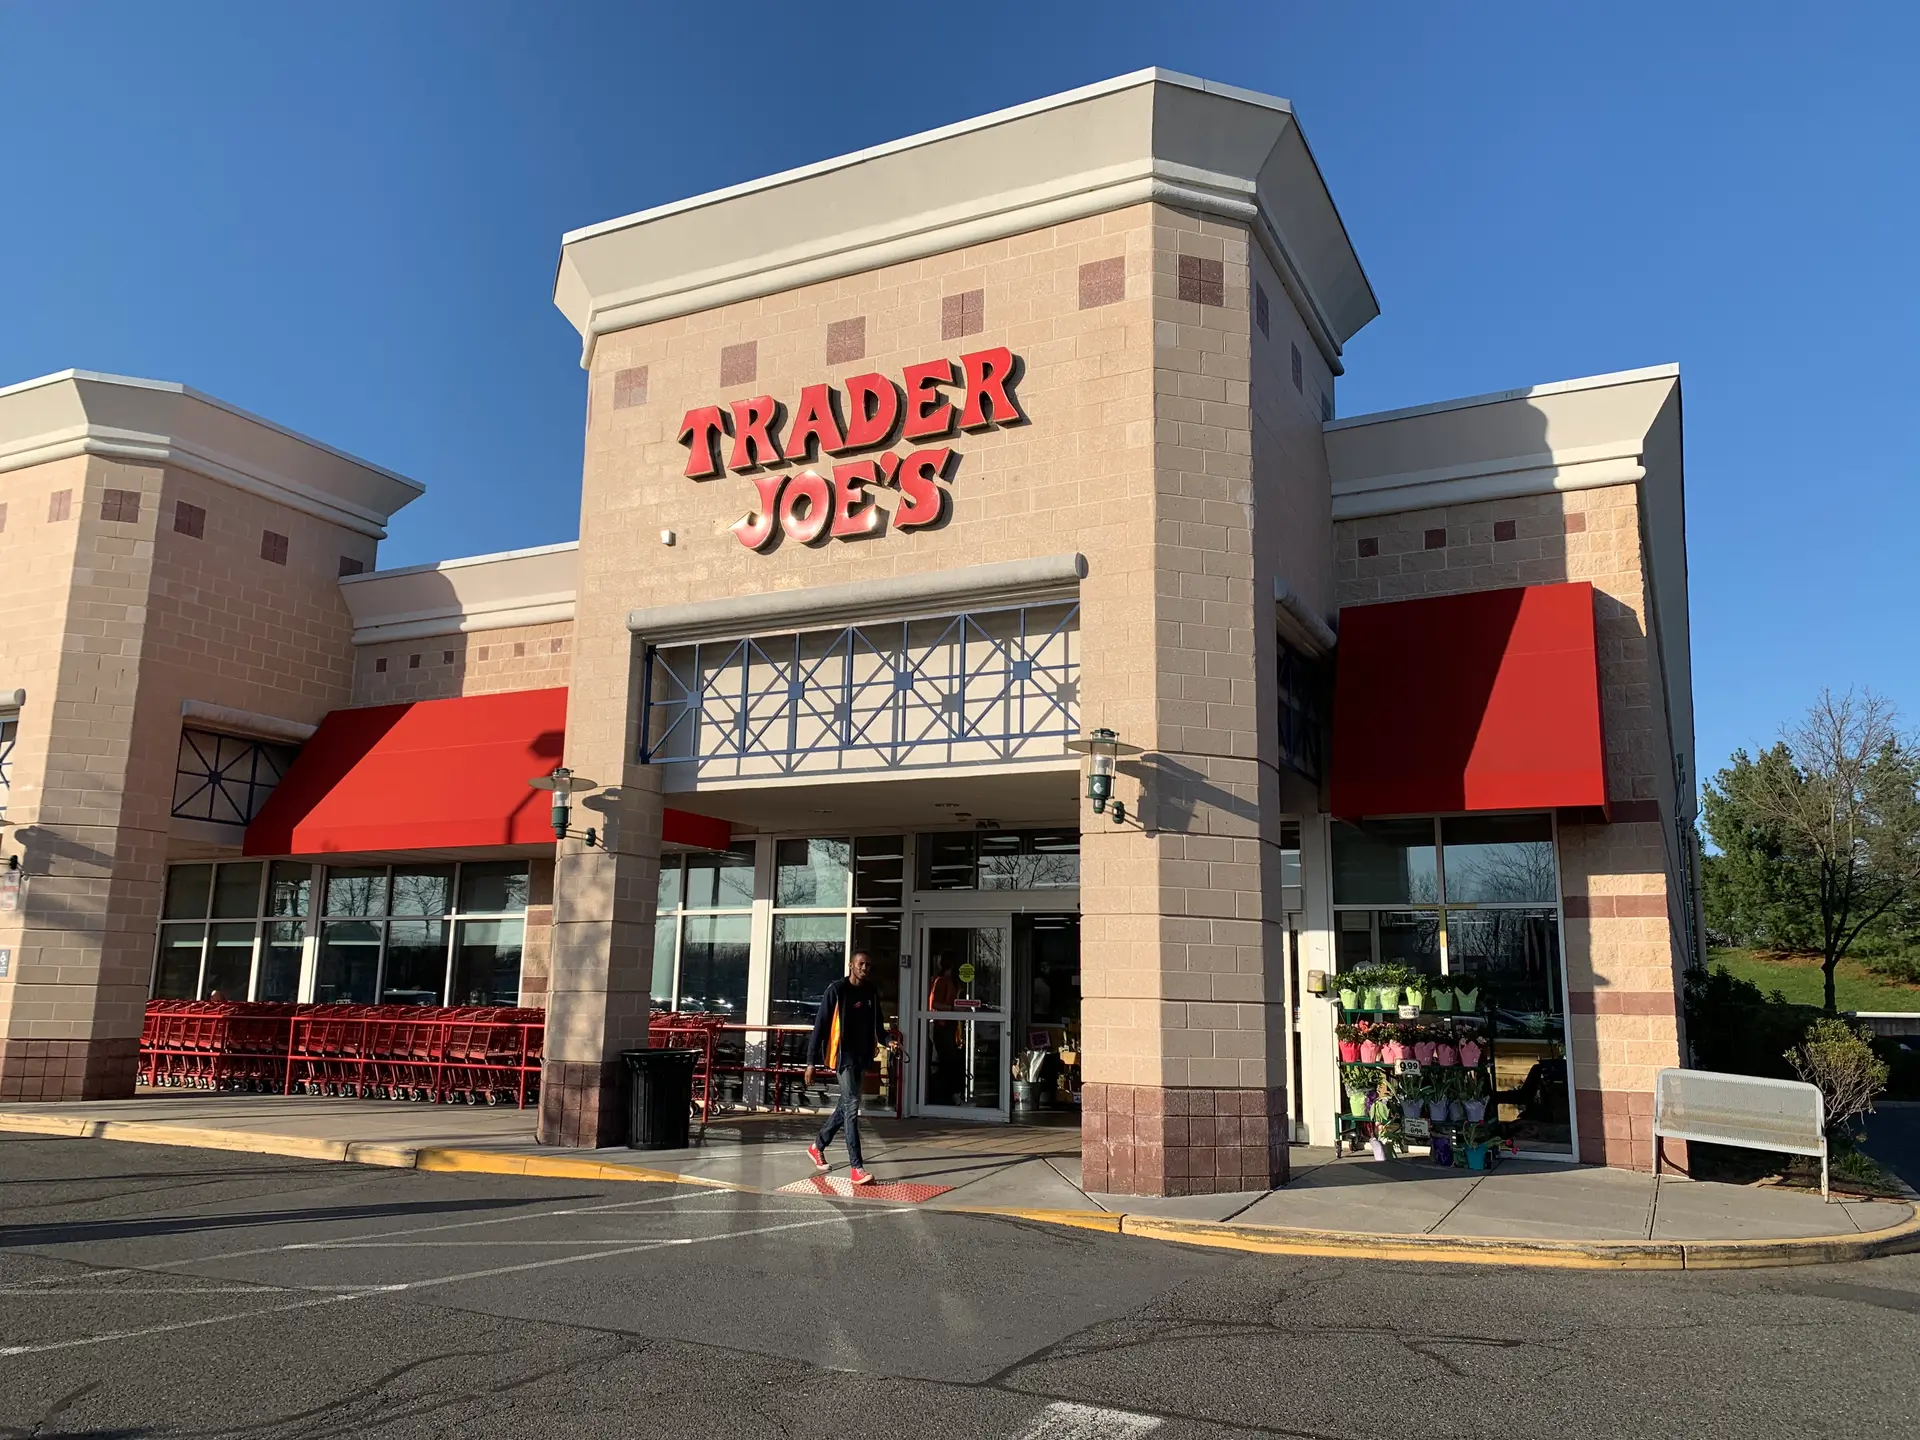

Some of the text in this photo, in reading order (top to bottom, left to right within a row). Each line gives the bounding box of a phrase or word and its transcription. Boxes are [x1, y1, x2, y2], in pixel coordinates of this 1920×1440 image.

[677, 346, 1027, 480] TRADER
[728, 447, 955, 552] JOE'S
[1400, 1061, 1418, 1072] 9.99
